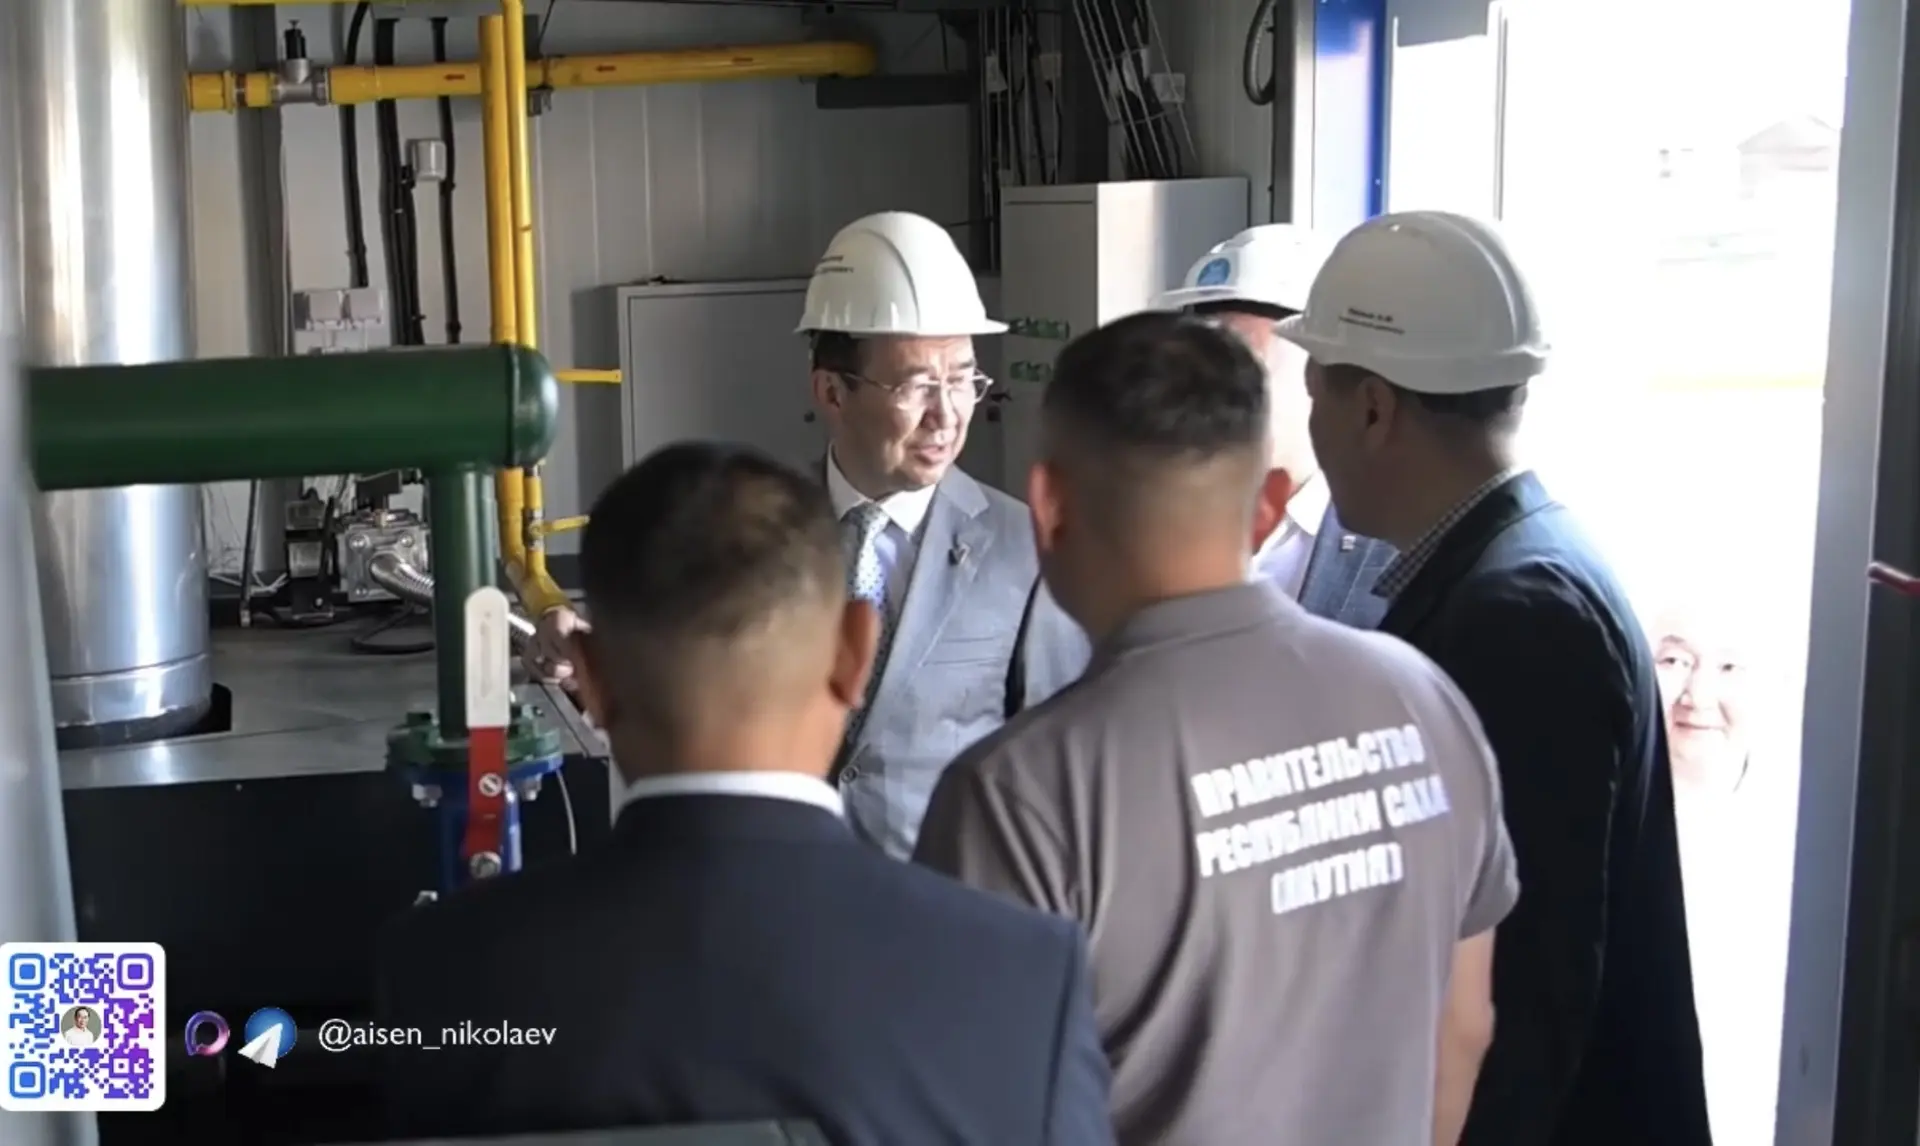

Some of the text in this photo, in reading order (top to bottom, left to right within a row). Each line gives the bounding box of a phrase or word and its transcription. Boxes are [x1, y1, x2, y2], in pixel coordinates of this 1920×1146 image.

[1191, 724, 1425, 818] ПРАВИТЕЛЬСТВО
[1196, 774, 1451, 878] РЕСПУБЛИКИ САХА
[1271, 841, 1404, 914] (ЯКУТИЯ)
